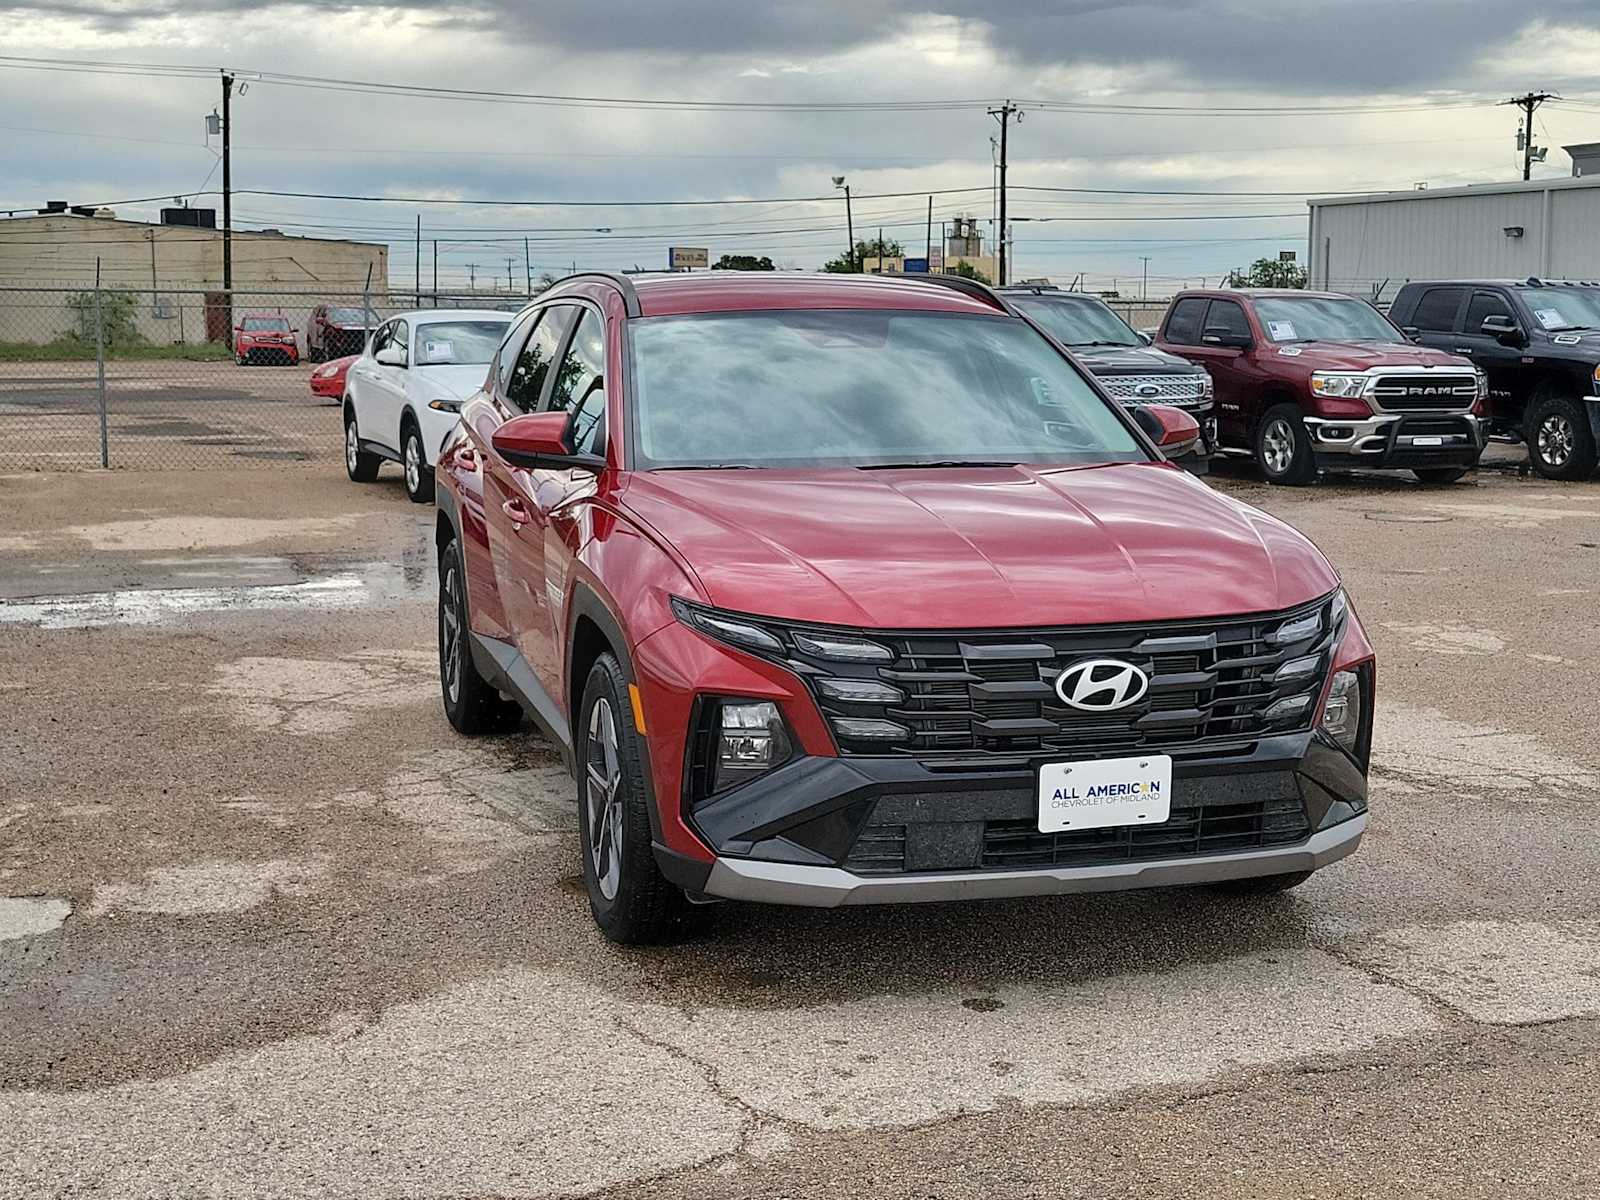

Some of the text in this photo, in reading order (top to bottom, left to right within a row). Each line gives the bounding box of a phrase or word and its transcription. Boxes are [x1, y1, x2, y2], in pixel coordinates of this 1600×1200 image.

[1409, 387, 1451, 395] RAM
[1052, 788, 1080, 800] ALL
[1051, 792, 1160, 809] CHEVROLET OF MIDLAND
